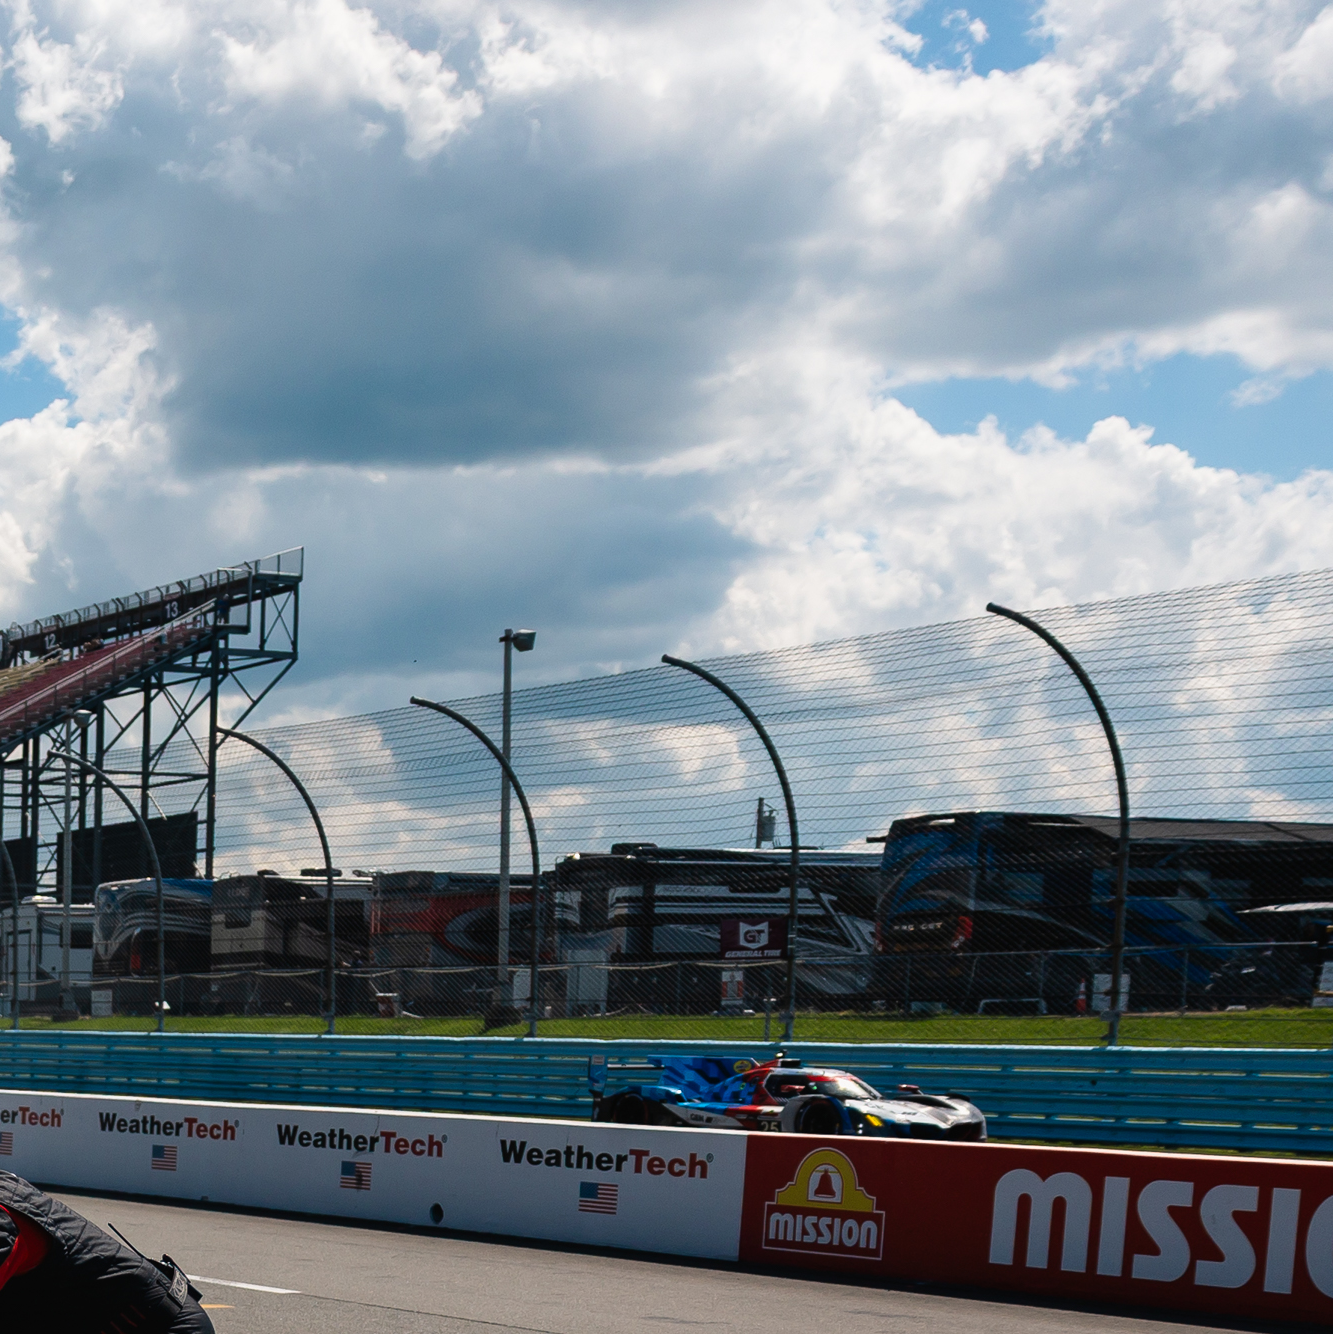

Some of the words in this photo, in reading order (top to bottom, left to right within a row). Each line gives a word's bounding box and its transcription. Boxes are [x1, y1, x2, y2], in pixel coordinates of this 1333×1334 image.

[98, 1111, 238, 1142] WeatherTech
[276, 1123, 447, 1158] WeatherTech
[499, 1138, 713, 1181] WeatherTech
